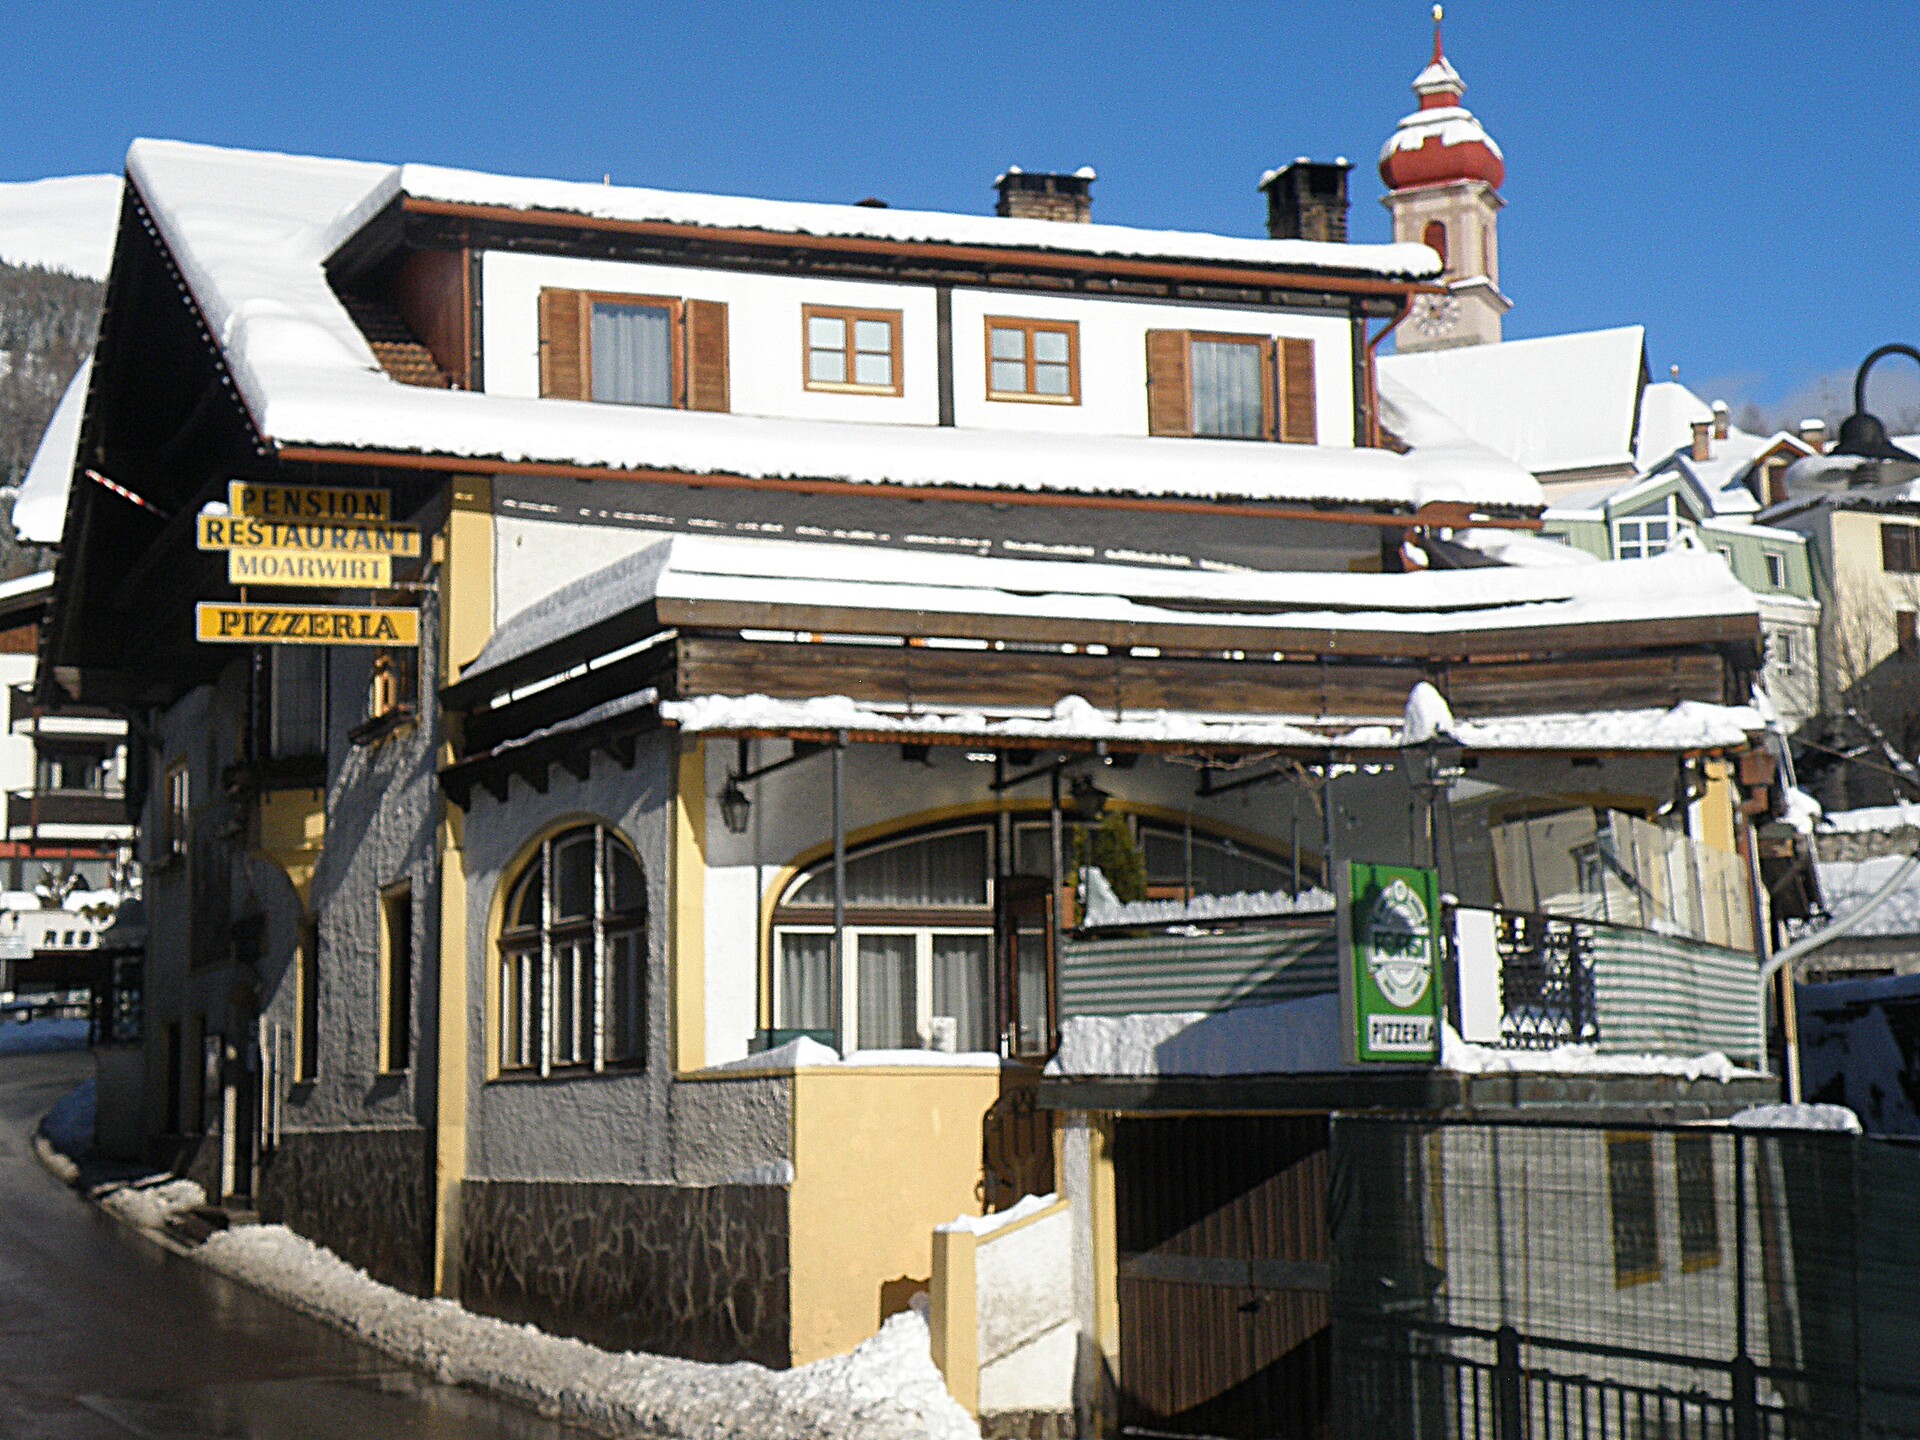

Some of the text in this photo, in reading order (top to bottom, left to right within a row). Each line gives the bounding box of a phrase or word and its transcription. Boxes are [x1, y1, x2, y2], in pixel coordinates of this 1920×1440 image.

[242, 488, 382, 516] PENSION
[206, 520, 411, 551] RESTAURANT
[236, 554, 382, 580] MOARWIRT
[218, 611, 399, 640] PIZZERIA
[1372, 1022, 1435, 1044] PIZZERIA
